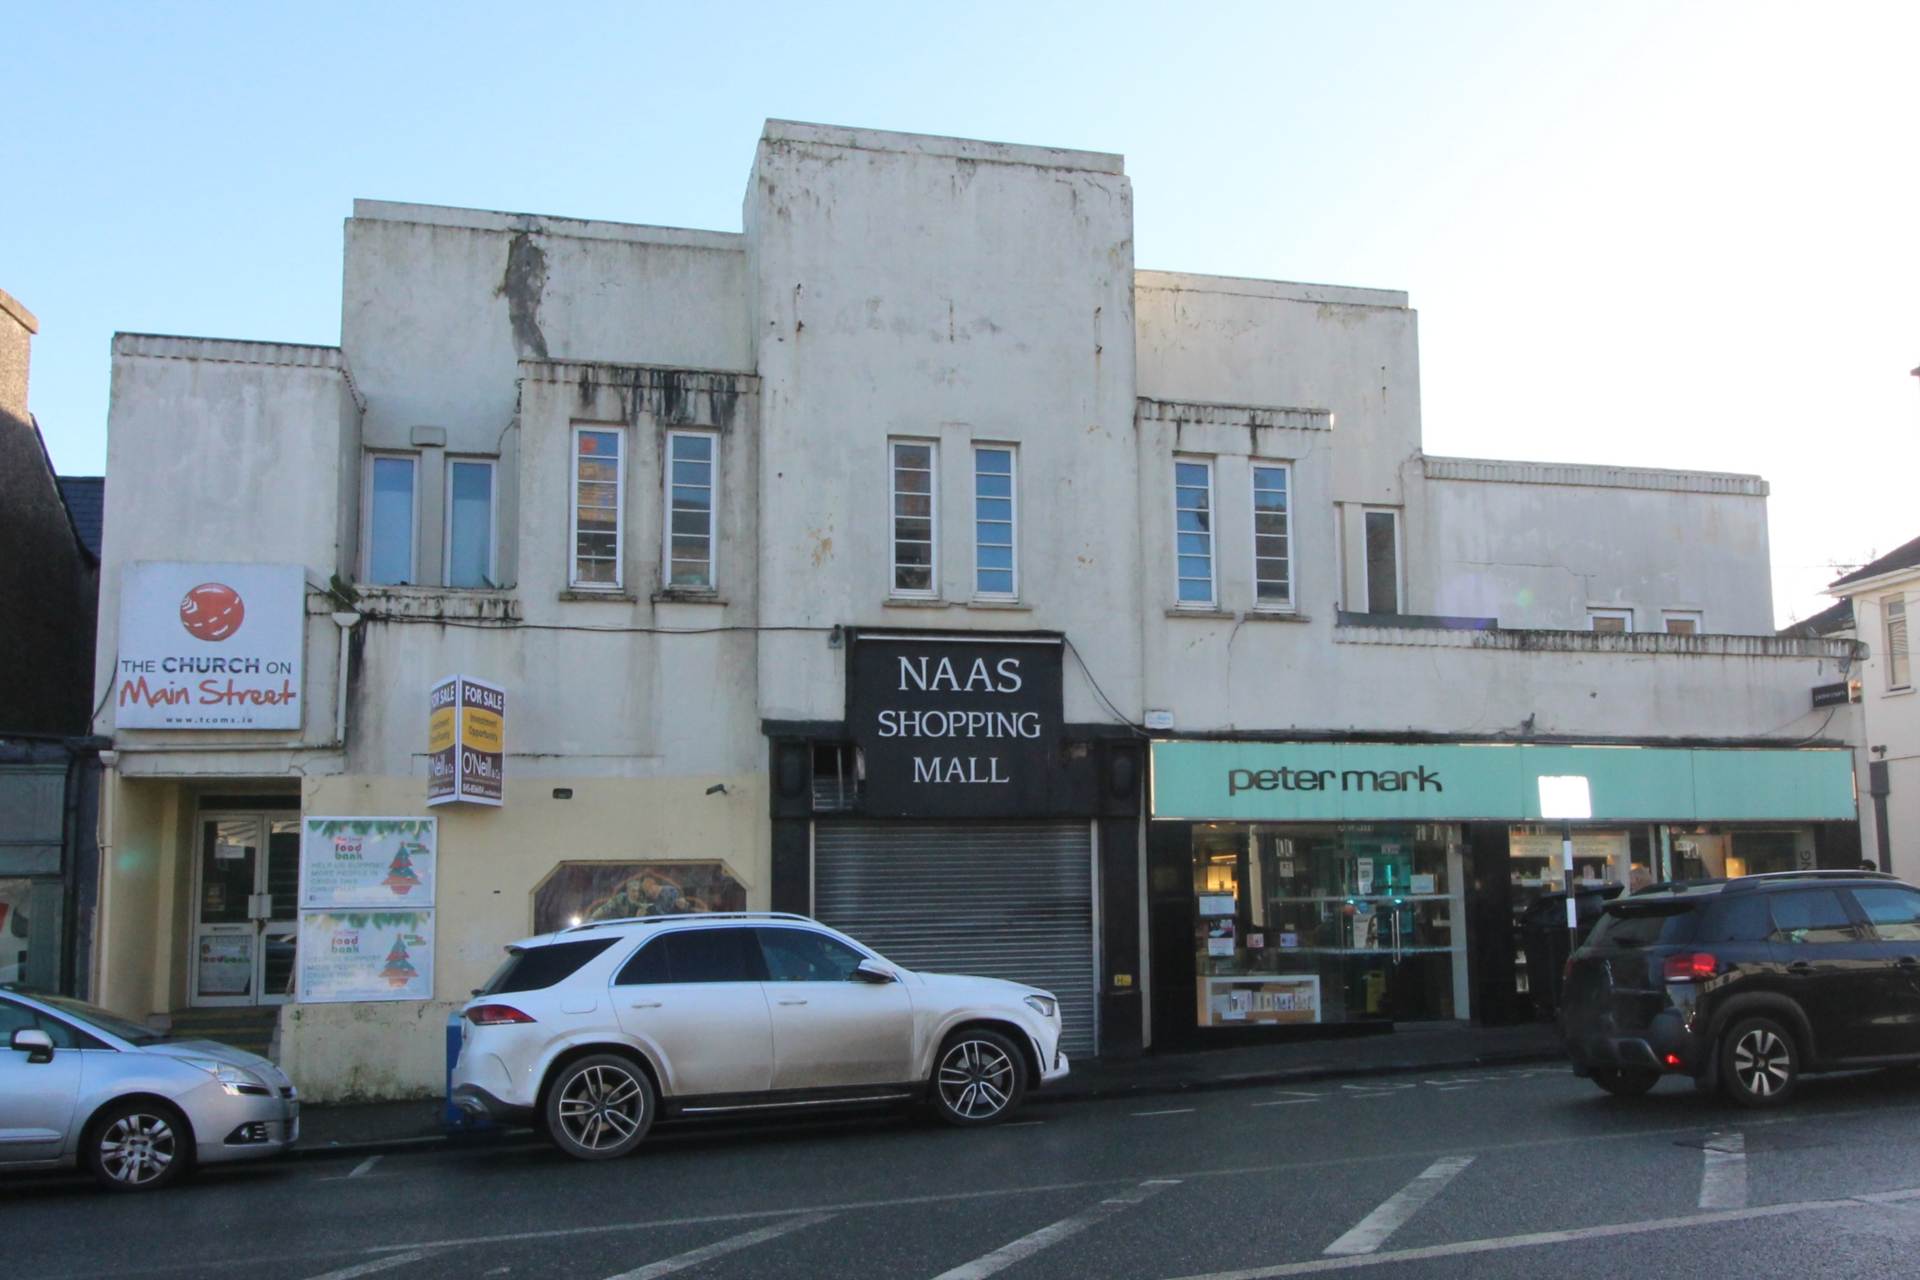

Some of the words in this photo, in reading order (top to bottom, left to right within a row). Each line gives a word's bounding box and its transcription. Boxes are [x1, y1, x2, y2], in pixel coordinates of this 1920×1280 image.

[121, 660, 156, 673] THE
[162, 656, 260, 674] CHURCH
[266, 661, 292, 675] ON
[897, 656, 1022, 693] NAAS
[119, 675, 190, 708] Main
[198, 678, 297, 706] Street
[464, 685, 483, 704] FOR
[483, 689, 502, 710] SALE
[878, 710, 1042, 739] SHOPPING
[913, 757, 1010, 783] MALL
[335, 843, 362, 852] food
[335, 852, 363, 860] bank
[331, 945, 360, 953] bank
[332, 936, 359, 945] food
